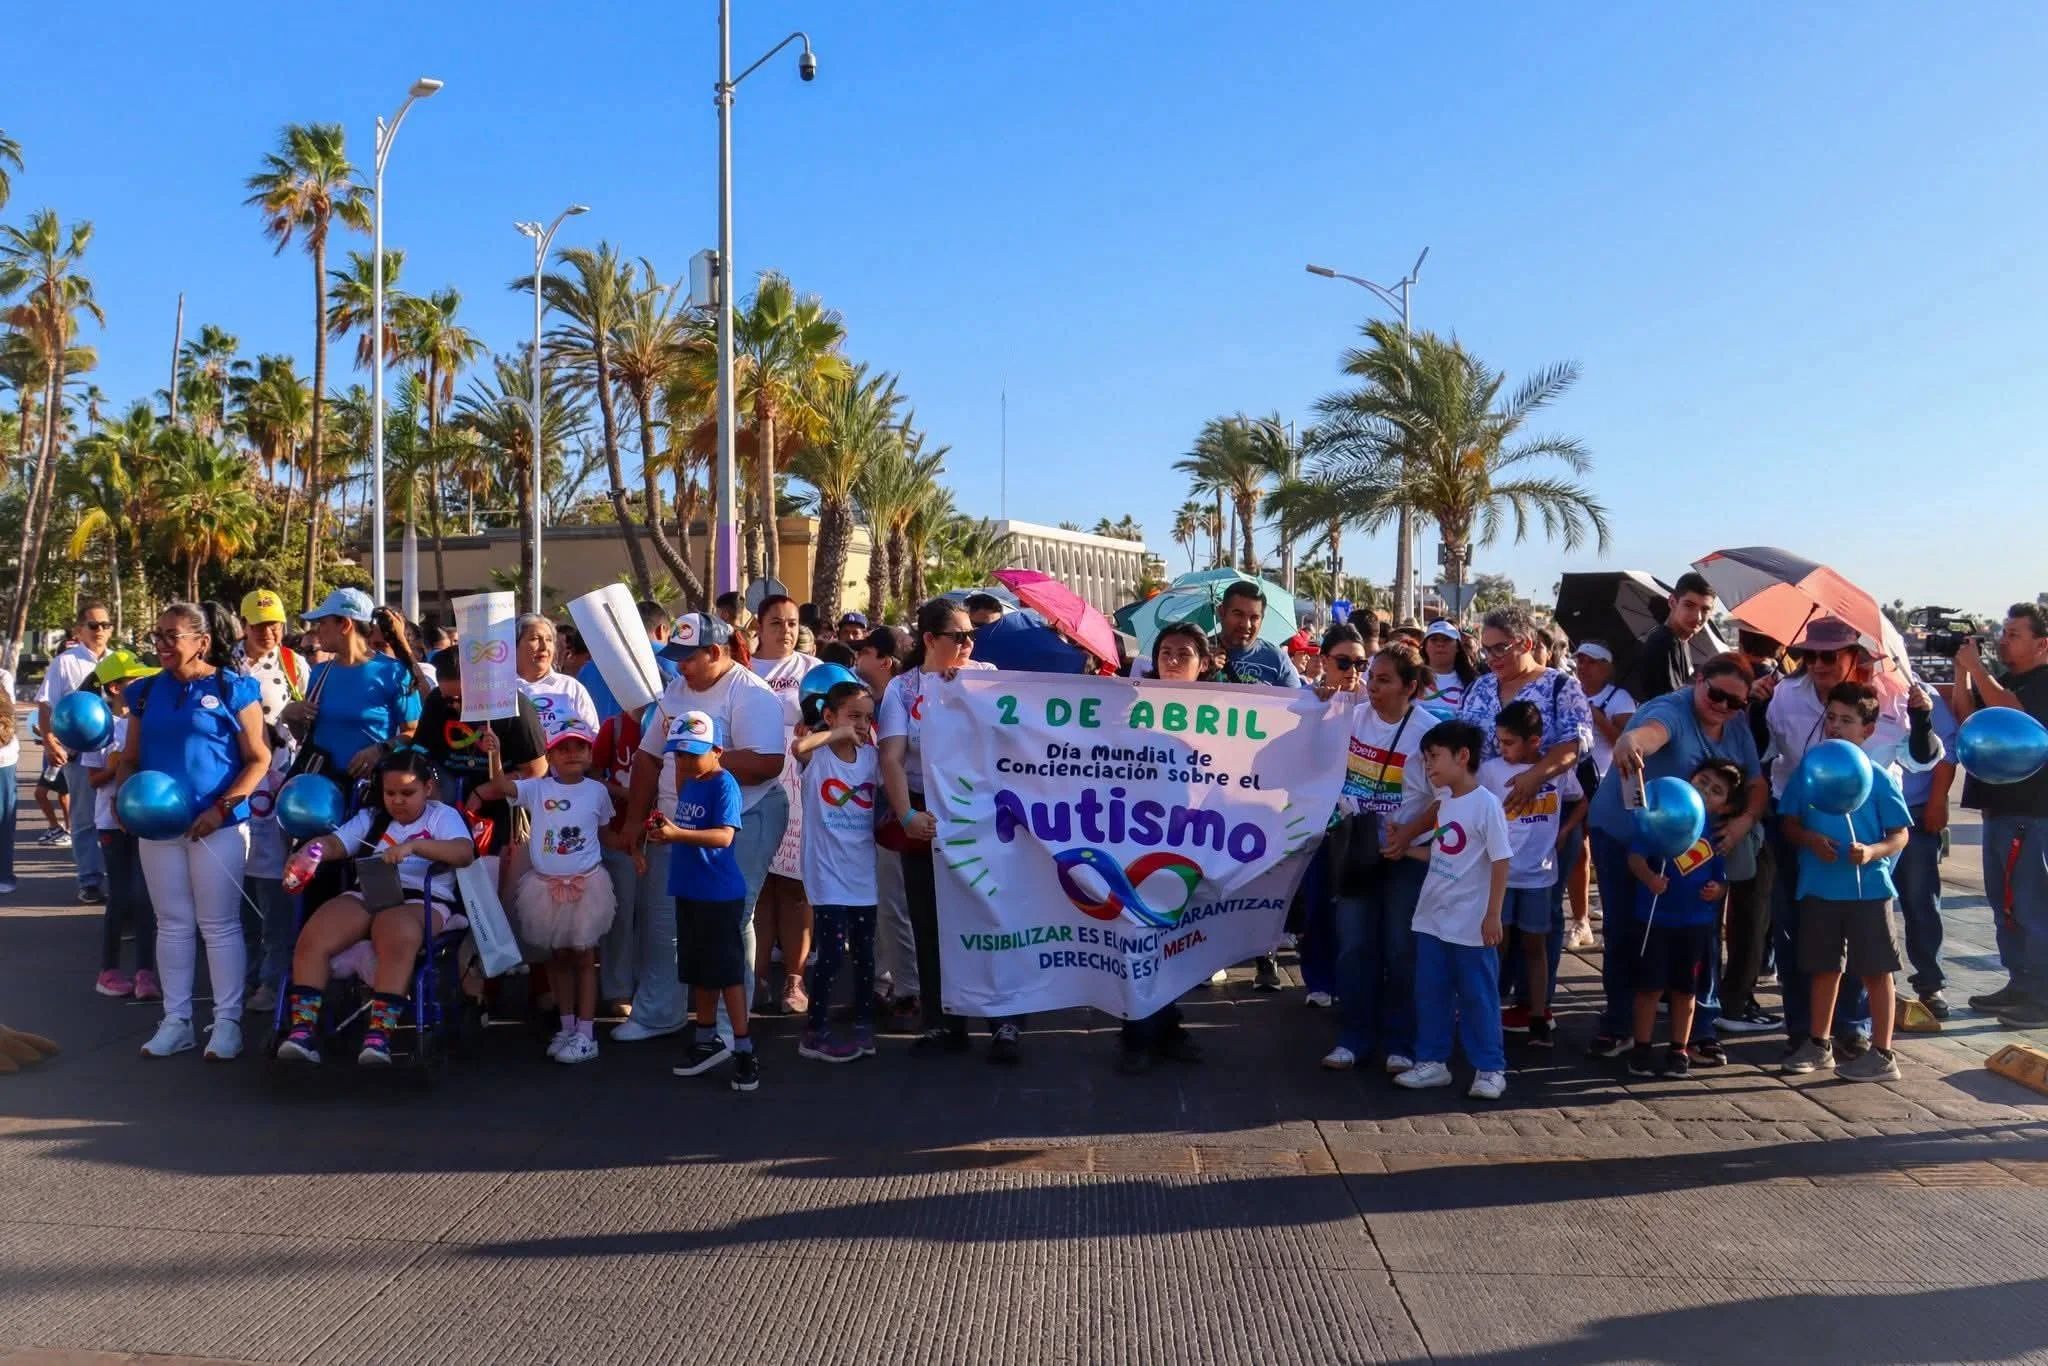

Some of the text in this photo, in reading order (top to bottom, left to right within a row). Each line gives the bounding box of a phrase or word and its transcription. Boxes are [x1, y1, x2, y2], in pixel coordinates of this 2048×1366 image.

[996, 695, 1267, 740] 2 DE ABRIL
[996, 757, 1261, 790] Concienciación sobre el
[1046, 743, 1212, 767] Día Mundial de
[994, 787, 1267, 863] Autismo
[960, 925, 1073, 952] VISIBILIZAR
[1078, 926, 1100, 945] ES
[1103, 930, 1119, 950] EL
[1119, 931, 1160, 955] INICI
[1039, 950, 1128, 980] DERECHOS
[1132, 959, 1152, 980] ES
[1163, 928, 1208, 961] META.
